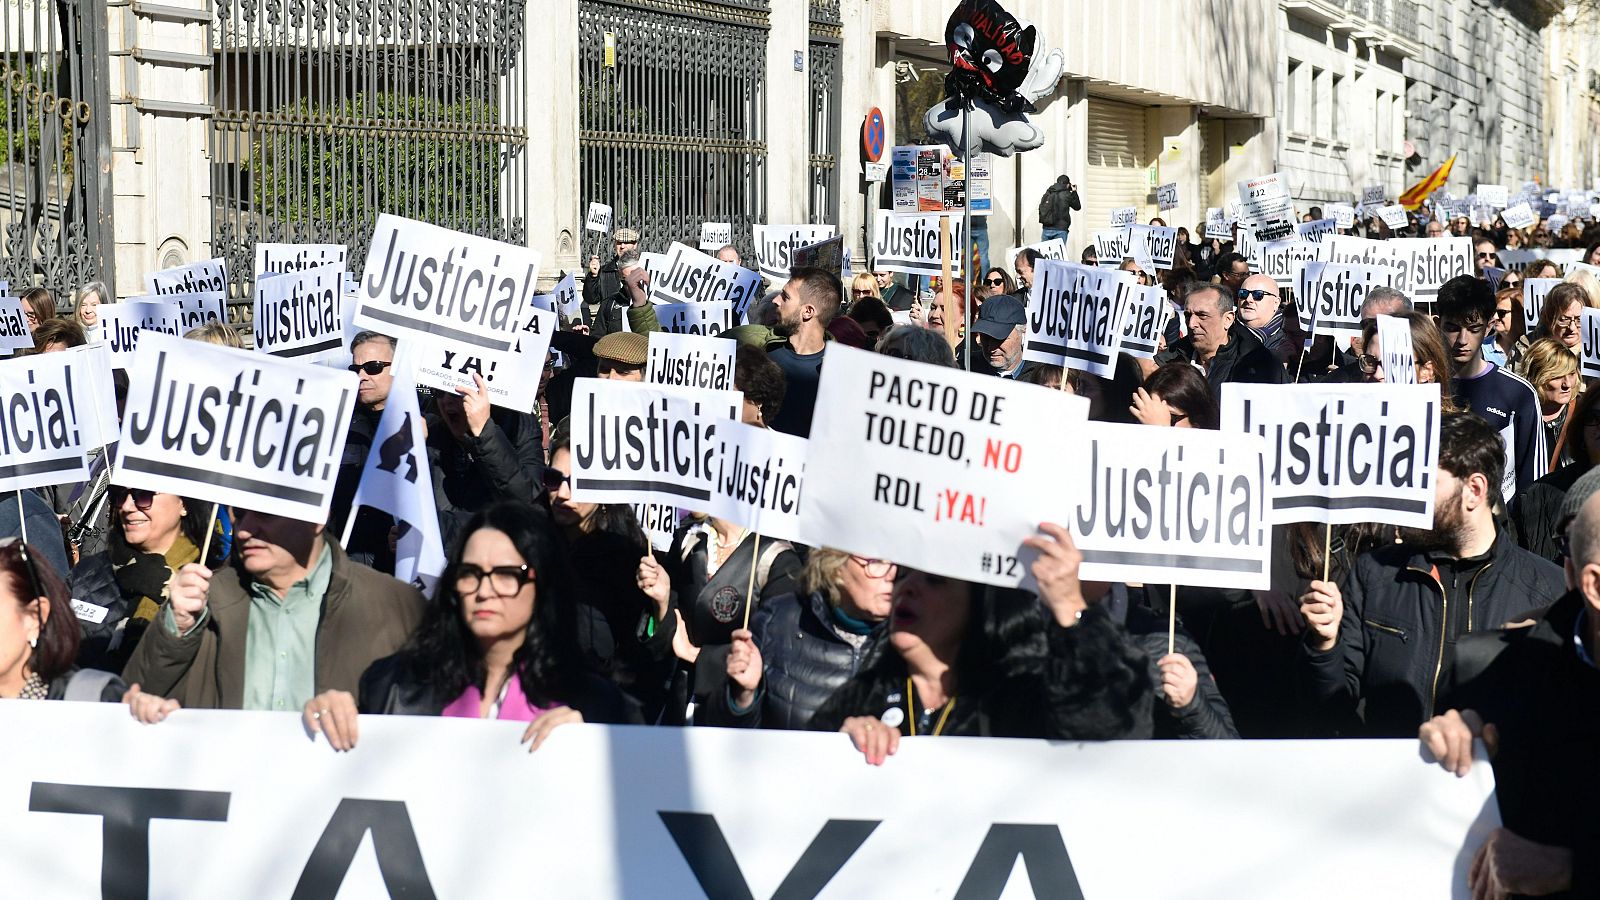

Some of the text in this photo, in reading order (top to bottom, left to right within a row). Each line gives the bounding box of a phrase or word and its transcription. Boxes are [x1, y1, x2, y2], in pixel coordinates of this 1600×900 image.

[1250, 188, 1266, 198] #J2
[878, 215, 960, 261] Justici!
[367, 228, 534, 333] Justicia!
[256, 272, 342, 349] Justicia!
[1031, 270, 1124, 347] Justicia!
[441, 350, 497, 382] YA!
[457, 377, 509, 396] PROCDORES
[650, 348, 733, 390] ¡Justicia!
[130, 351, 349, 481] Justicia!
[868, 370, 1006, 426] PACTO DE
[1486, 406, 1507, 418] adidas
[865, 412, 1023, 473] TOLEDO, NO
[874, 473, 987, 527] RDL ¡YA!
[981, 552, 1018, 578] #J2
